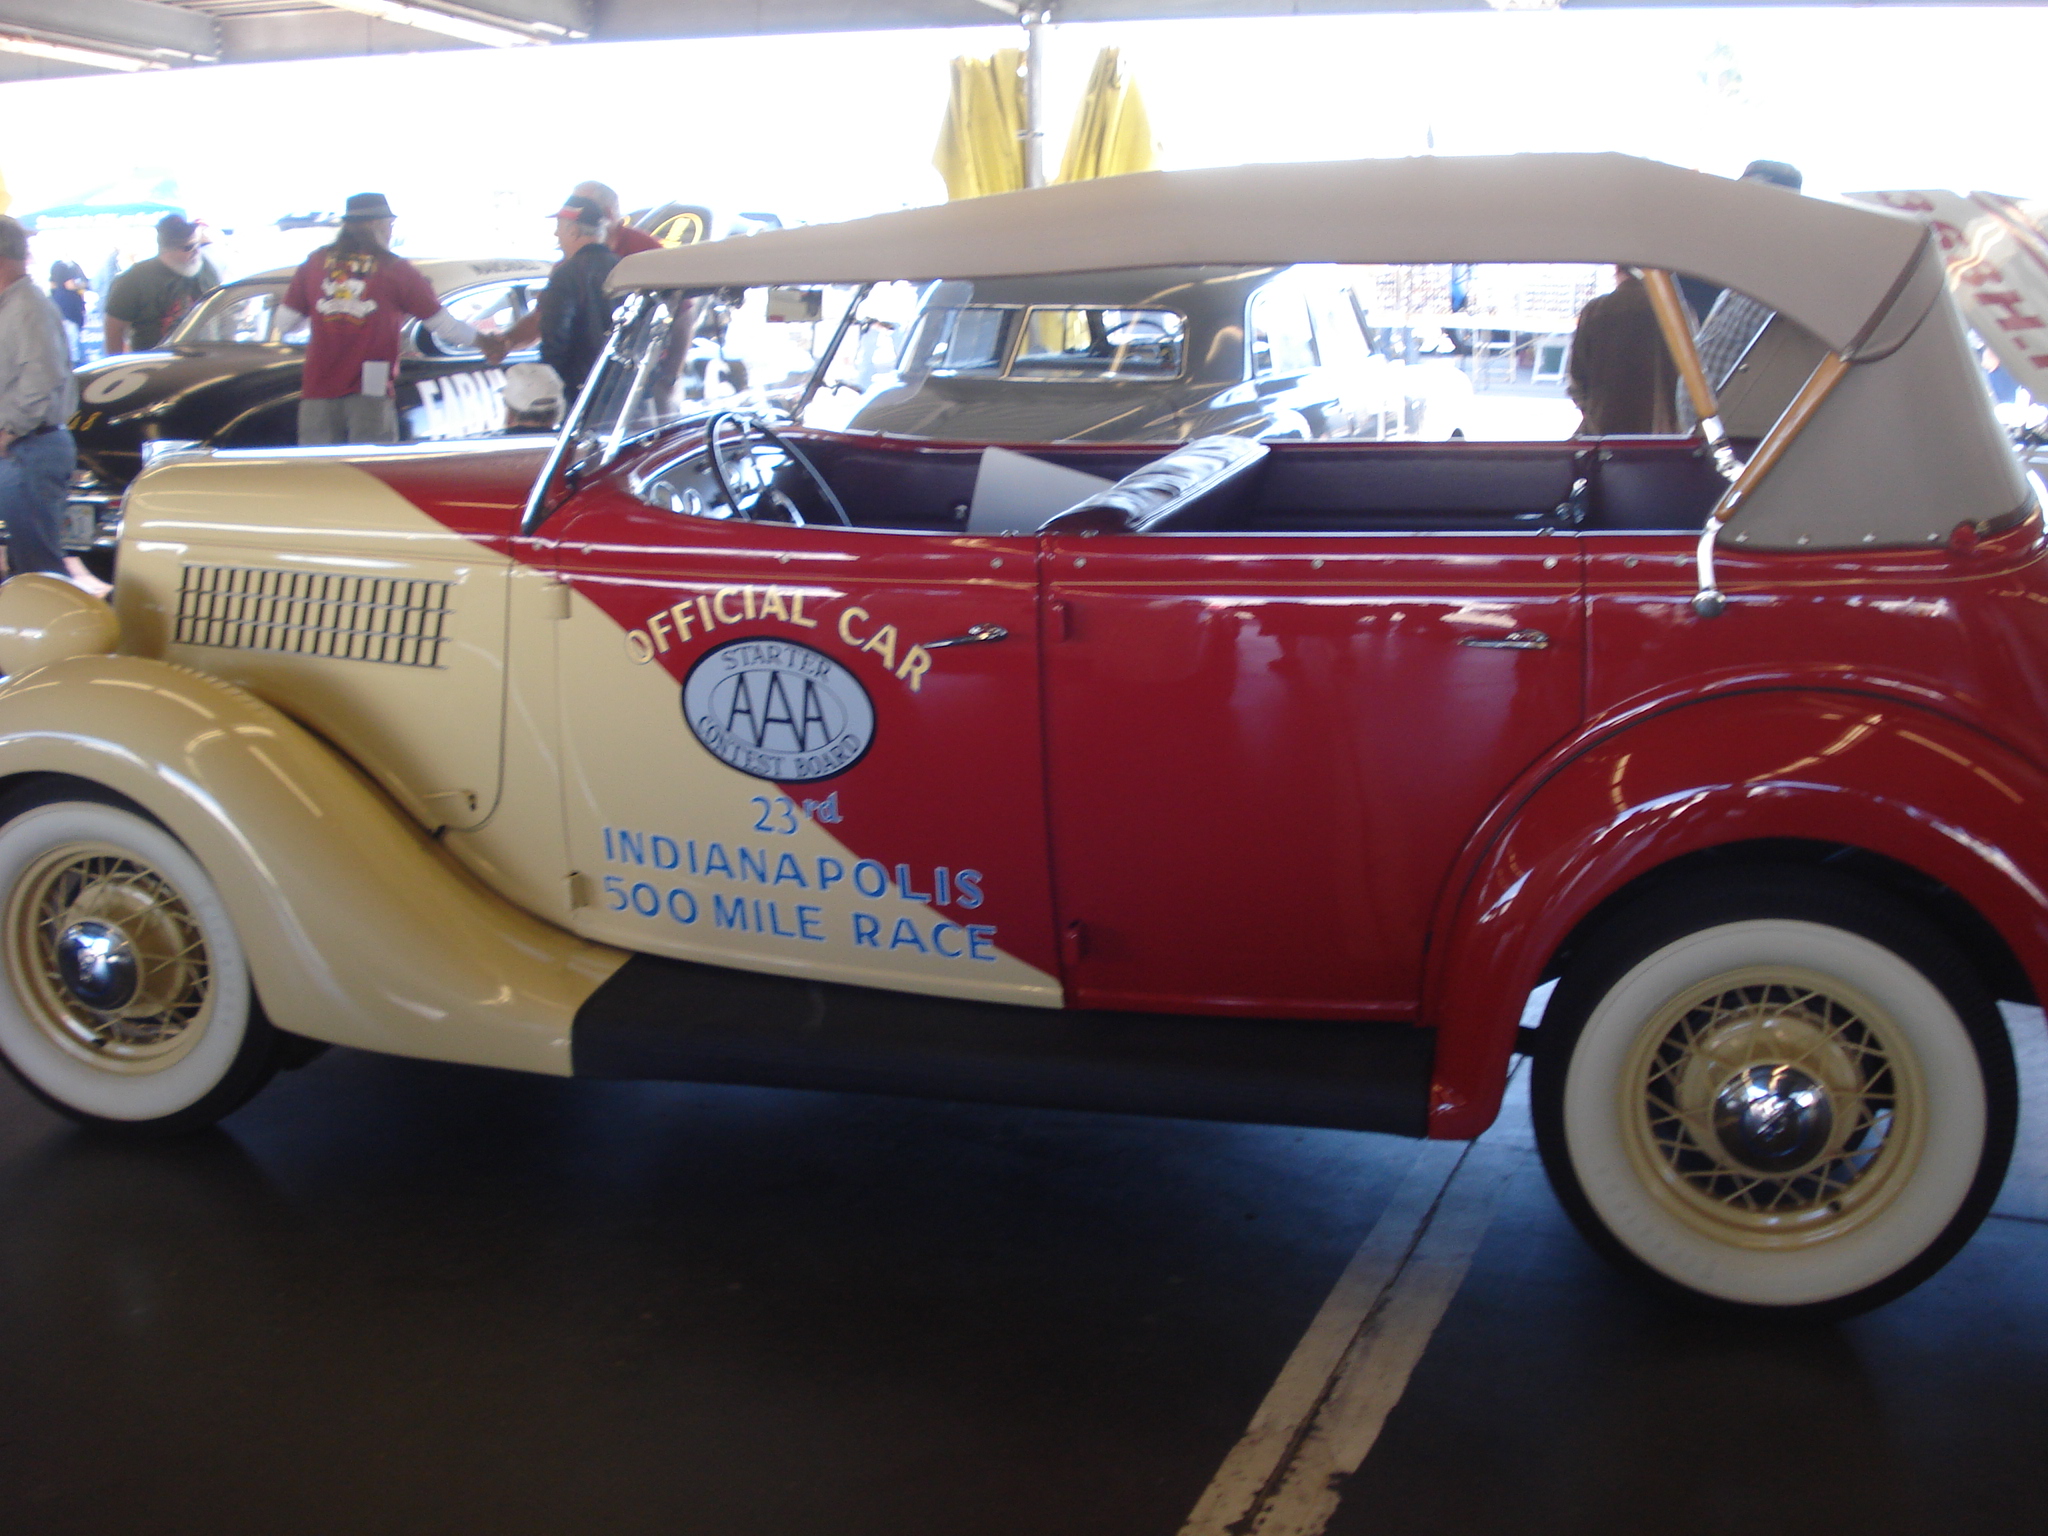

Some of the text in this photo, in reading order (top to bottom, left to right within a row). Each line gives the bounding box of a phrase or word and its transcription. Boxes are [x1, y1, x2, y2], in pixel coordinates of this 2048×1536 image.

[624, 584, 932, 693] OFFICIAL CAR
[721, 645, 832, 683] STARTER
[699, 716, 862, 779] CONTEST BOARD
[726, 670, 833, 753] AAA
[750, 791, 844, 836] 23rd
[603, 827, 984, 909] INDIANAPOLIS
[603, 876, 998, 962] 500 MILE RACE
